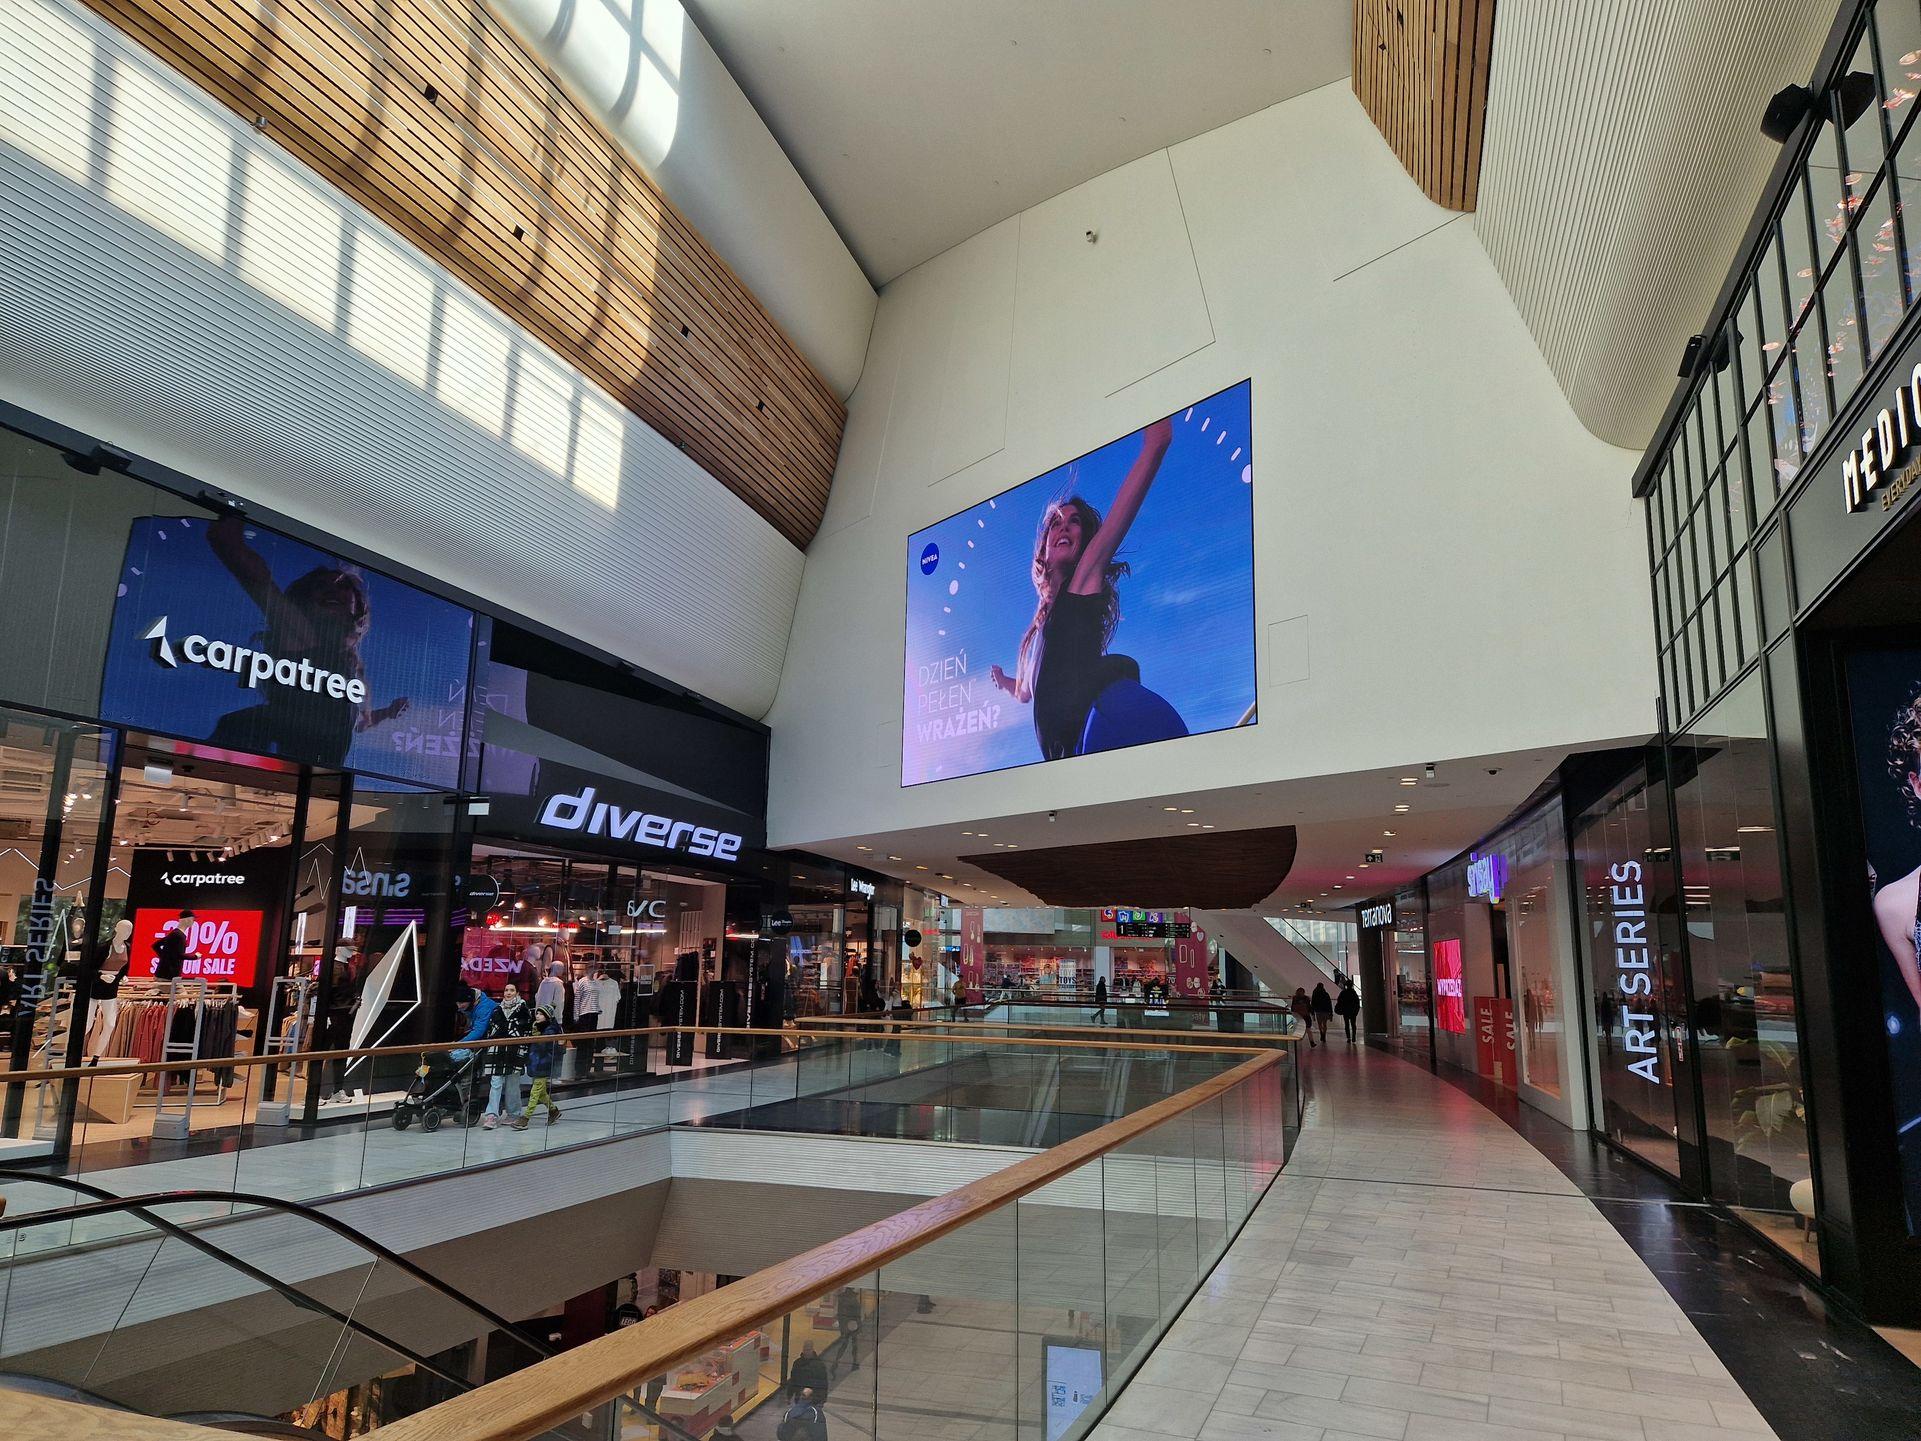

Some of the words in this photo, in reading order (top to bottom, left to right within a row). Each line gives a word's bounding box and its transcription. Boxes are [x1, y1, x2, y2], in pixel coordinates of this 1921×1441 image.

[922, 553, 938, 565] NIVEA
[184, 634, 366, 704] carpatree
[918, 648, 967, 686] DZIEŃ
[917, 700, 1001, 742] WRAŻEŃ?
[540, 787, 743, 861] diverse
[173, 873, 245, 887] carpatree
[1610, 860, 1652, 996] SERIES
[202, 958, 236, 975] SALE
[1480, 1008, 1494, 1043] SALE
[1622, 1004, 1660, 1085] ART
